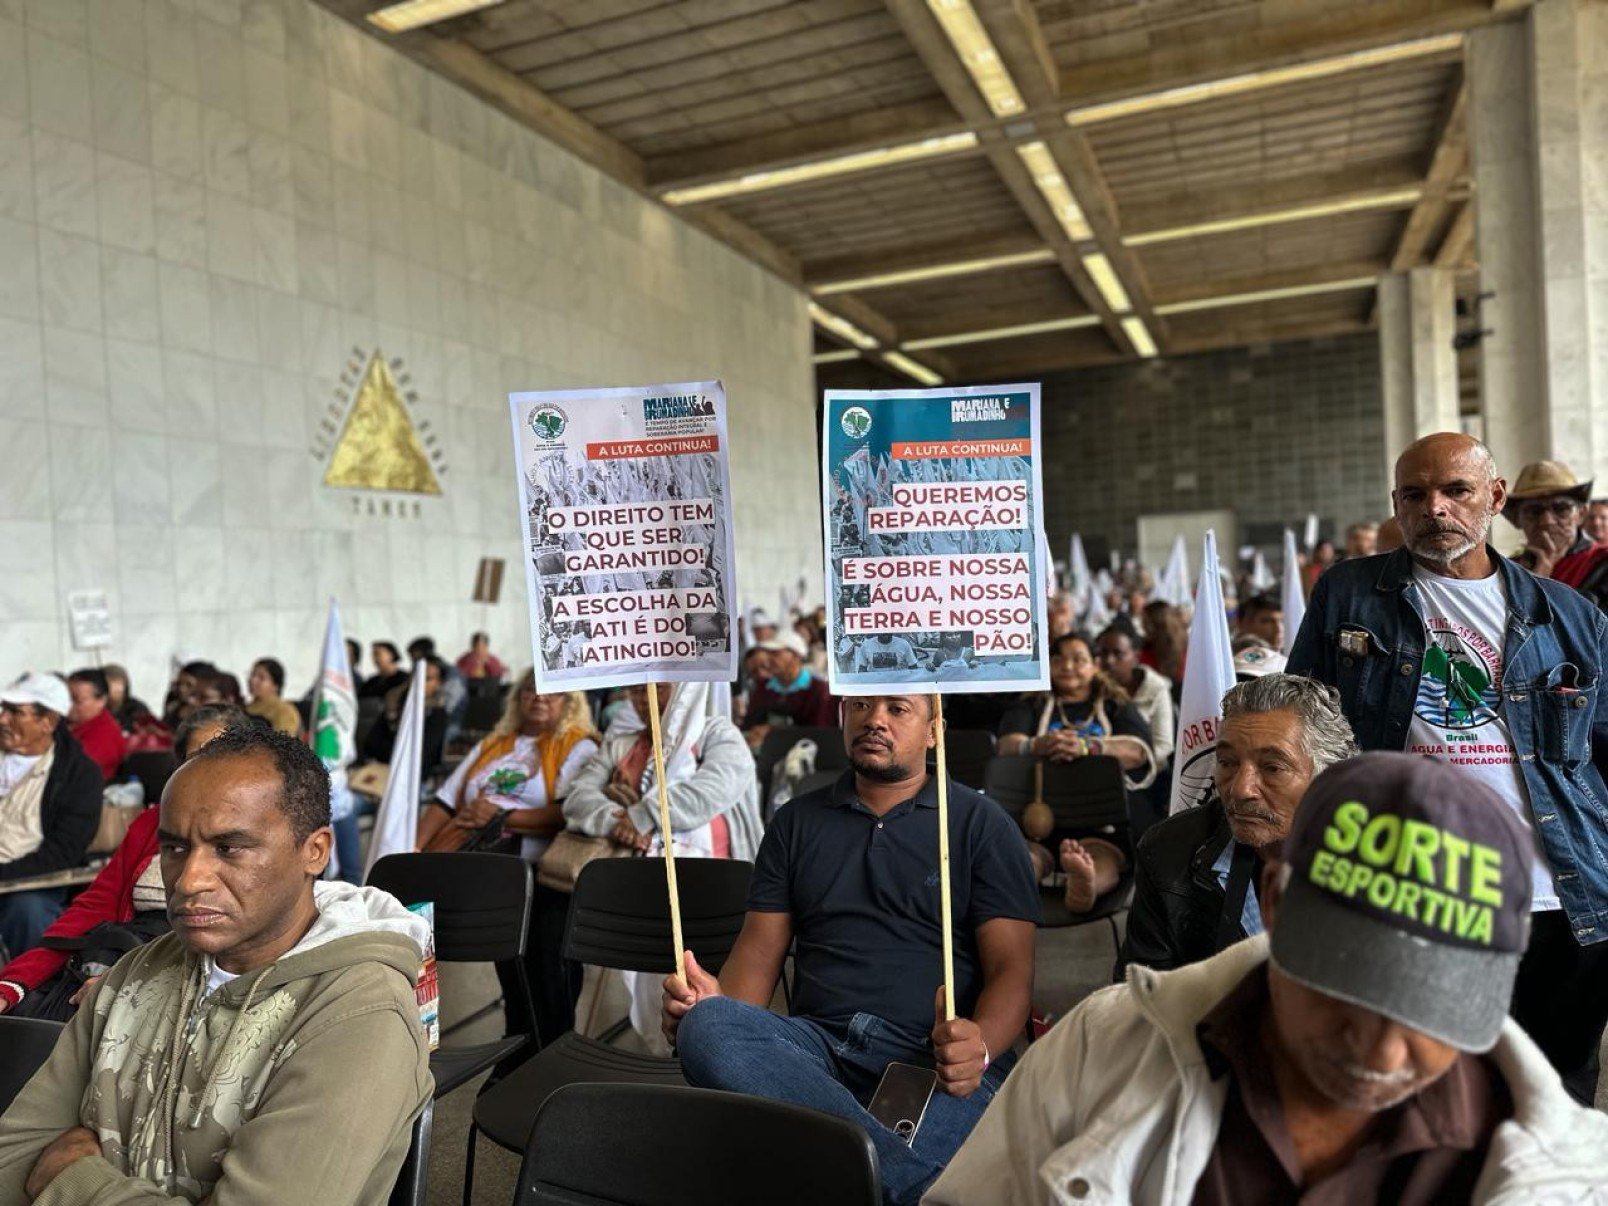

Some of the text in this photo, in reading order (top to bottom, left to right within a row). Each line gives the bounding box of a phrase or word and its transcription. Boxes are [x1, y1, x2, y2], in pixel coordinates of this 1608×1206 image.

[951, 397, 1010, 412] MARIANA E
[599, 440, 711, 456] A LUTA CONTINUA!
[904, 442, 1023, 456] A LUTA CONTINUA!
[894, 485, 1026, 508] QUEREMOS
[549, 503, 714, 528] O DIREITO TEM
[870, 504, 1021, 531] REPARAÇÃO!
[587, 528, 682, 550] QUE SER
[566, 548, 705, 572] GARANTIDO!
[843, 558, 1029, 580] É SOBRE NOSSA
[870, 582, 1030, 604] ÁGUA, NOSSA
[553, 592, 716, 617] A ESCOLHA DA
[592, 615, 684, 638] ATI É DO
[845, 608, 1031, 629] TERRA E NOSSO
[974, 630, 1032, 650] PÃO!
[583, 641, 696, 662] ATINGIDO!
[1446, 733, 1478, 742] Brasil
[1448, 745, 1456, 754] E
[1323, 800, 1504, 908] SORTE
[1308, 850, 1494, 946] ESPORTIVA
